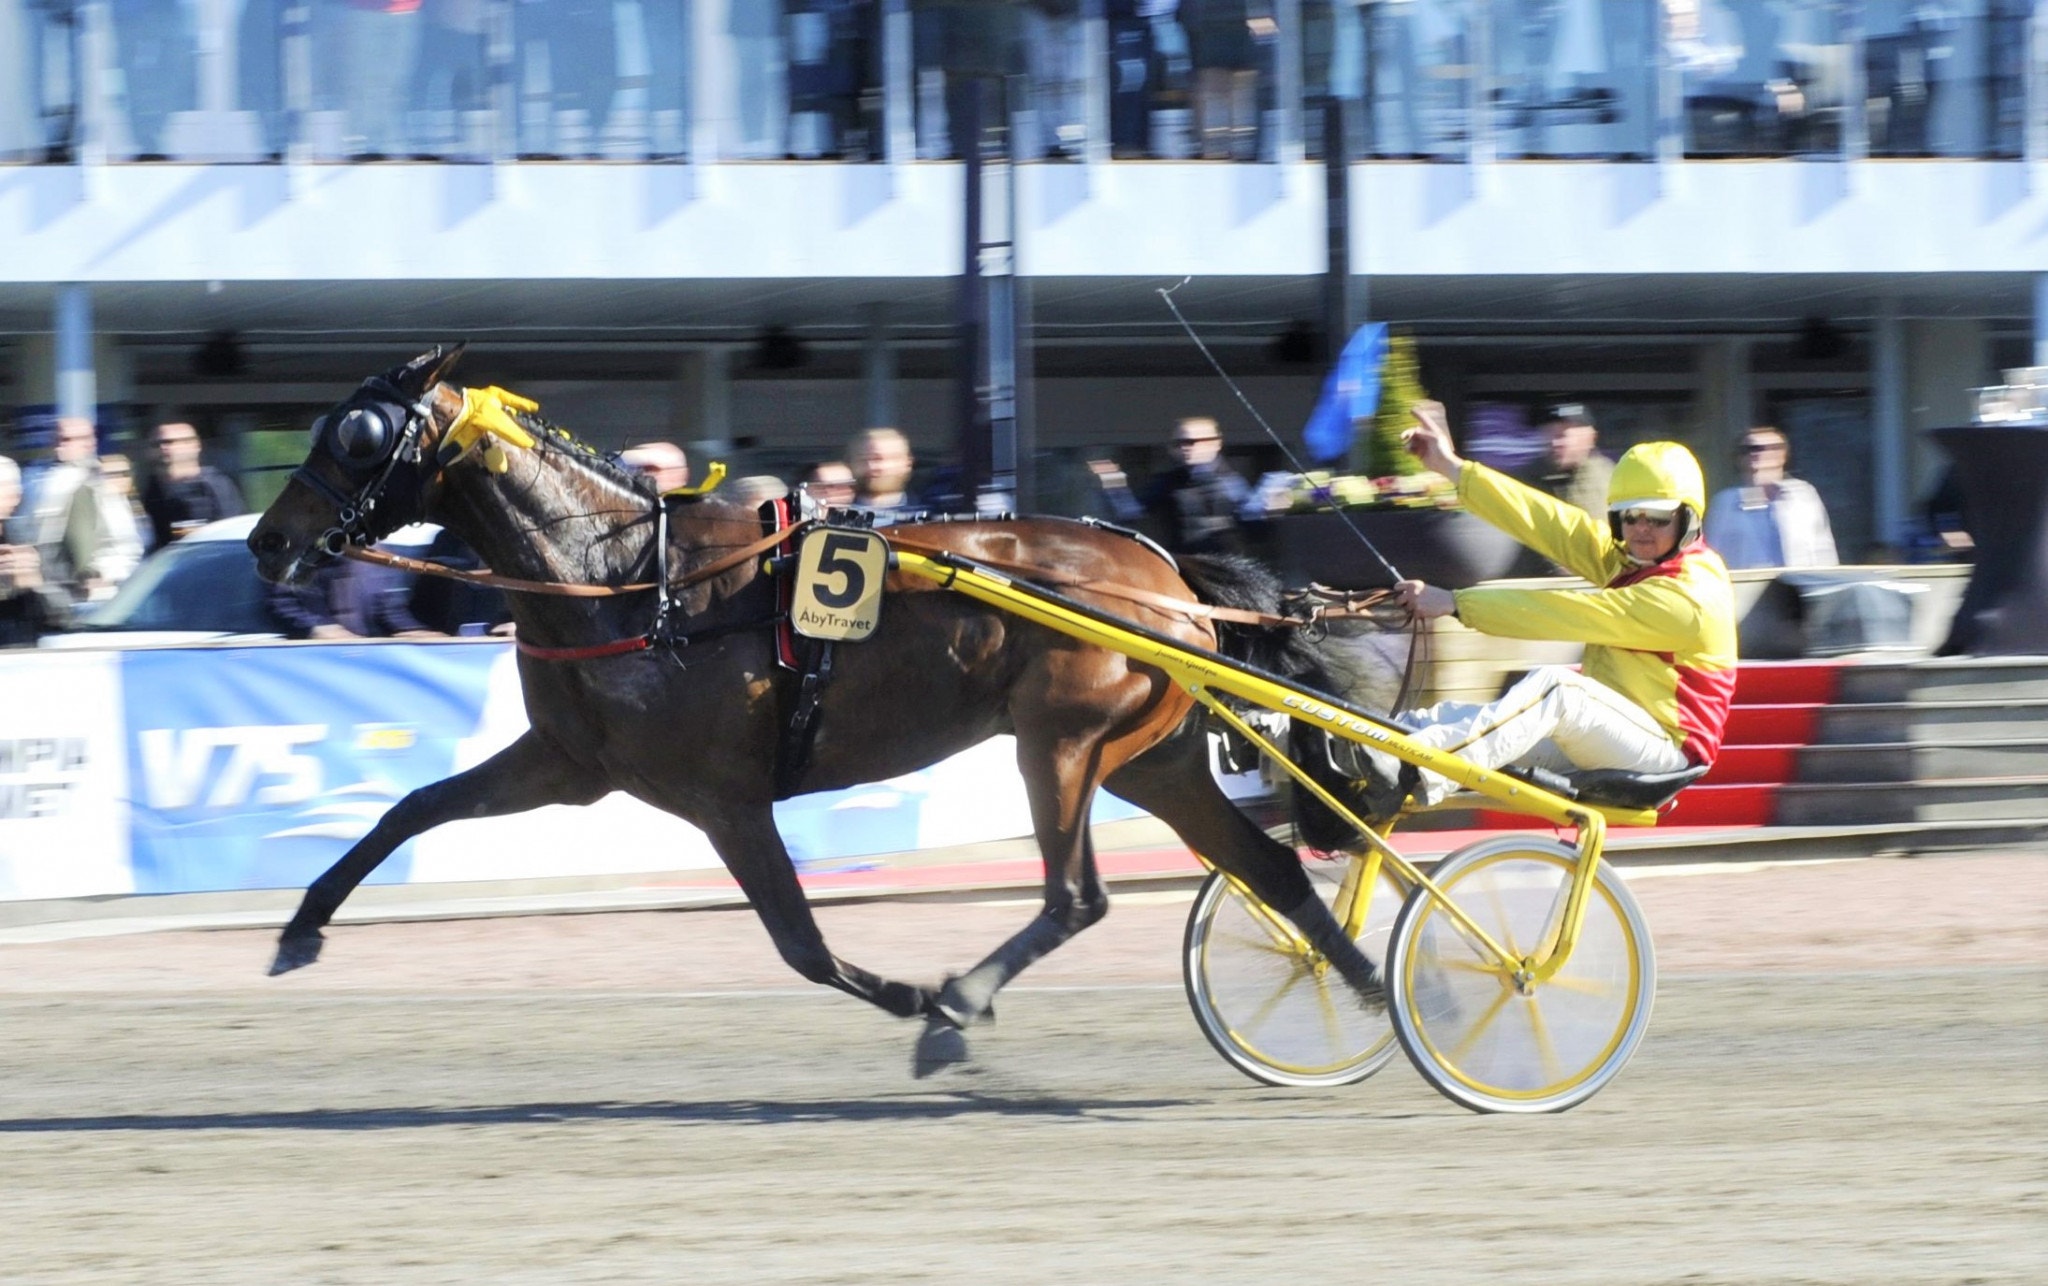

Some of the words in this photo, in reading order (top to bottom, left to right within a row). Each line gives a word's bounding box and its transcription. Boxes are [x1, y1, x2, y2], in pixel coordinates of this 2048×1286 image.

[813, 533, 870, 609] 5
[799, 607, 872, 631] ÅbyTravet
[1282, 694, 1390, 743] CUSTOM
[137, 723, 330, 809] V75
